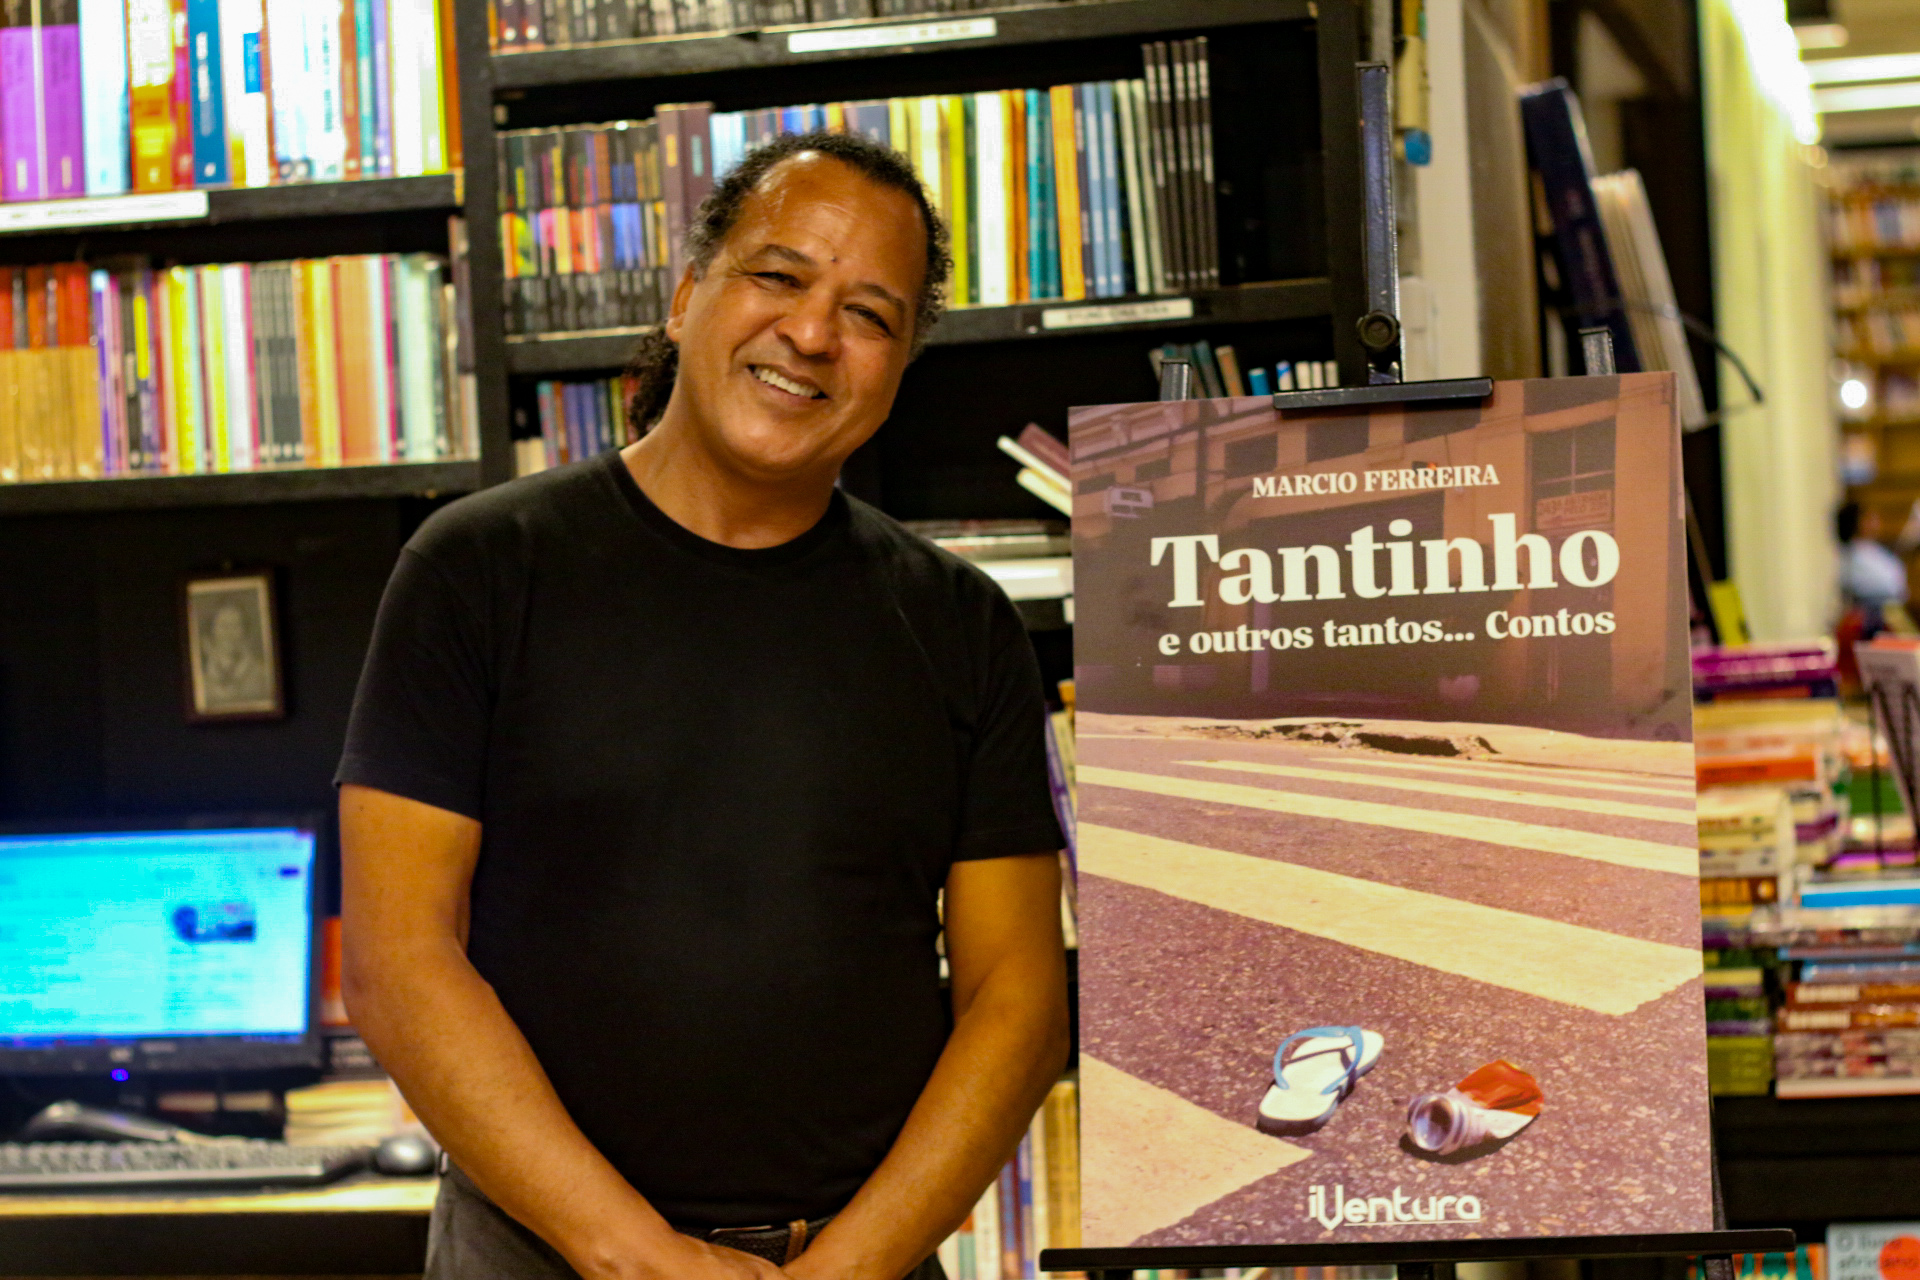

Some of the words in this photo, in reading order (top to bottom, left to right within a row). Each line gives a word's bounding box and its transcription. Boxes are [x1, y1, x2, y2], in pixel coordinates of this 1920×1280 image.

[1252, 471, 1358, 499] MARCIO
[1363, 463, 1500, 492] FERREIRA
[1150, 512, 1621, 608] Tantinho
[1158, 633, 1180, 656] e
[1189, 623, 1313, 655] outros
[1322, 615, 1475, 649] tantos...
[1485, 608, 1617, 640] Contos
[1308, 1185, 1481, 1231] iVentura
